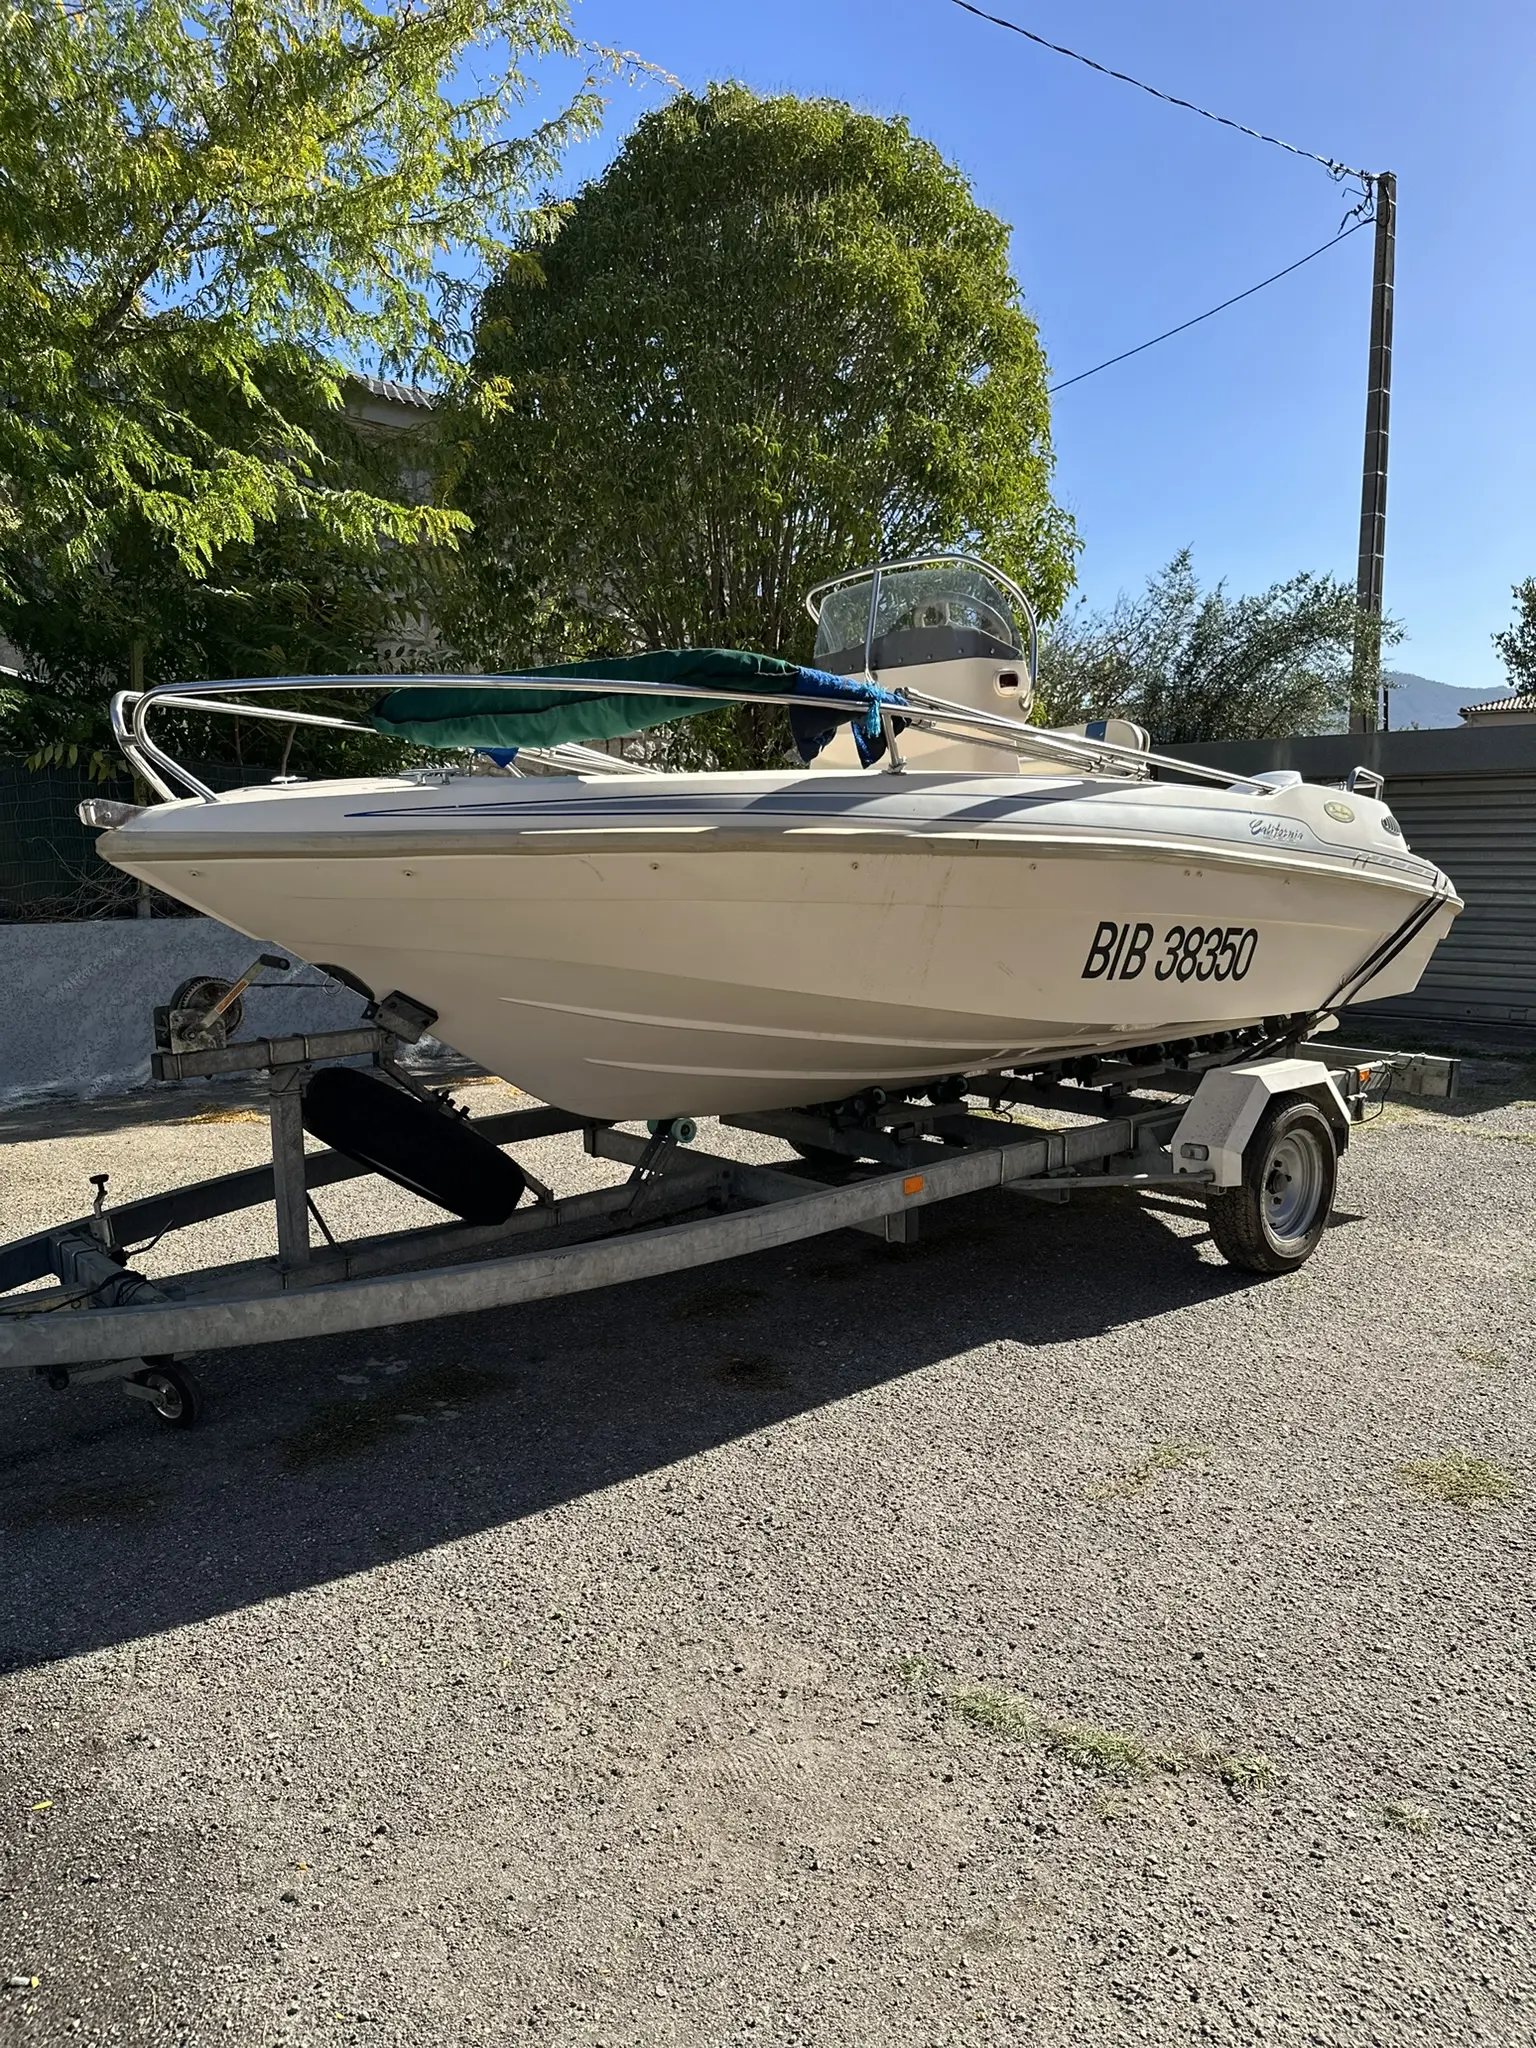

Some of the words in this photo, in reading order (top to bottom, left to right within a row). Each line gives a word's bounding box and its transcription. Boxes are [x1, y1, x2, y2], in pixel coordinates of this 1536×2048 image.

[1249, 819, 1304, 840] California
[1081, 921, 1155, 980] BIB
[1154, 925, 1258, 982] 38350
